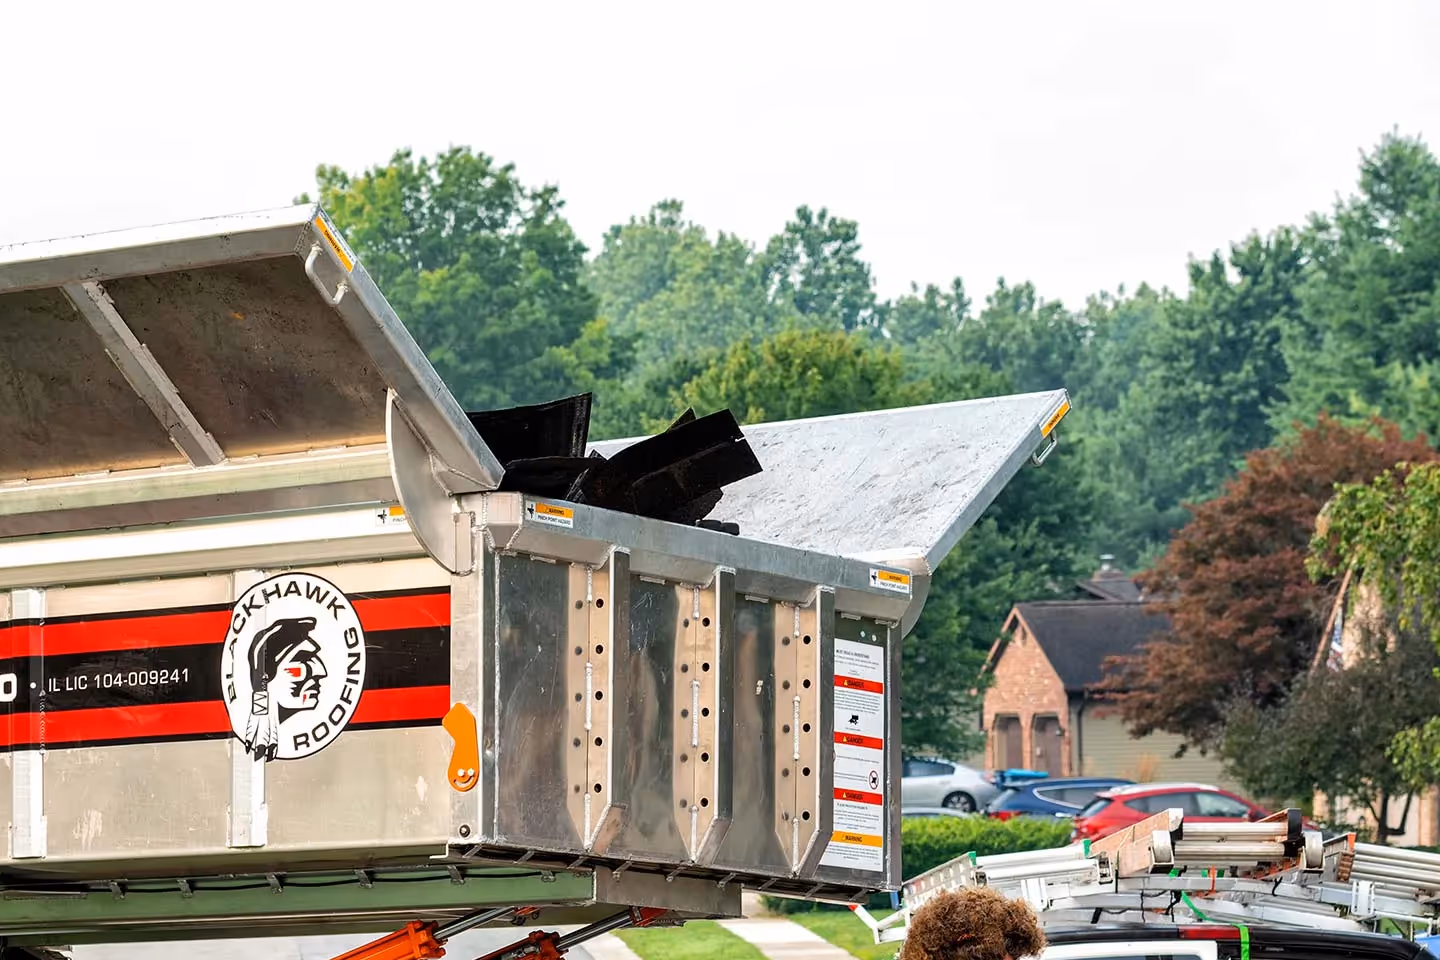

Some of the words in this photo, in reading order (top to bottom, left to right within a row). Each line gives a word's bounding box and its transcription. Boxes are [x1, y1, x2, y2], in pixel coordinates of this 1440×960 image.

[48, 677, 61, 692] IL
[65, 674, 89, 692] LIC
[93, 667, 190, 689] 104-009241
[226, 580, 347, 705] BLACKHAWK
[292, 626, 361, 751] ROOFING
